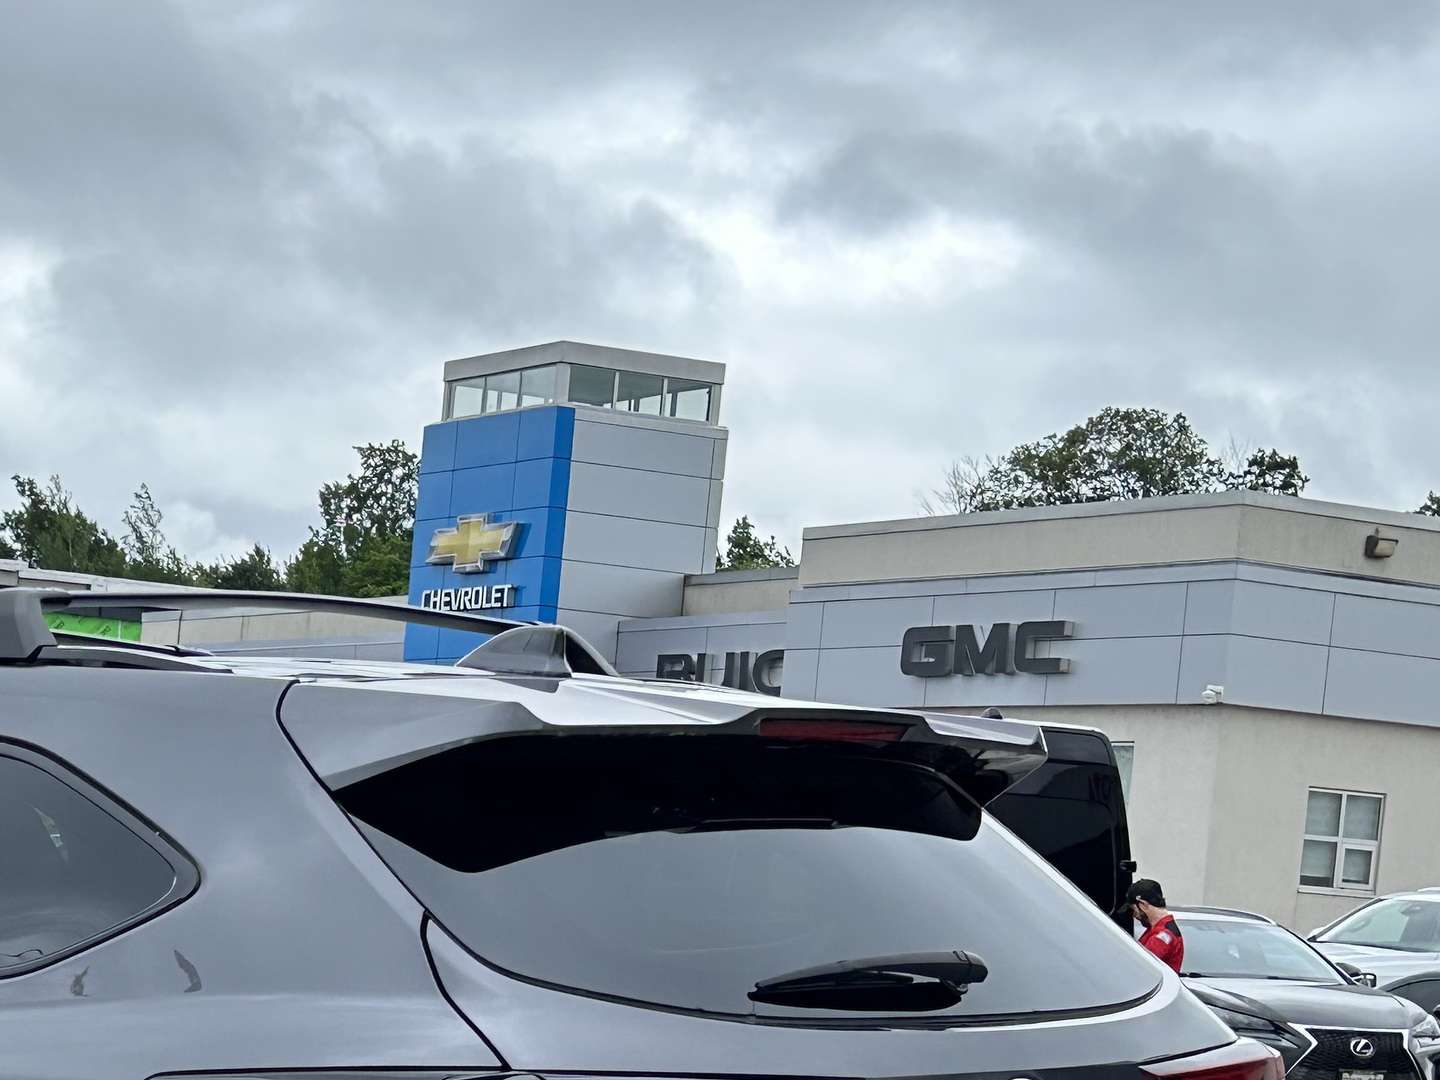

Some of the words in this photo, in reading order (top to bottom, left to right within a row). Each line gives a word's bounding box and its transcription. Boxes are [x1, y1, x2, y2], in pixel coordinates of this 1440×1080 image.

[421, 584, 512, 611] CHEVROLET
[900, 620, 1073, 678] GMC
[656, 650, 785, 698] BUIC
